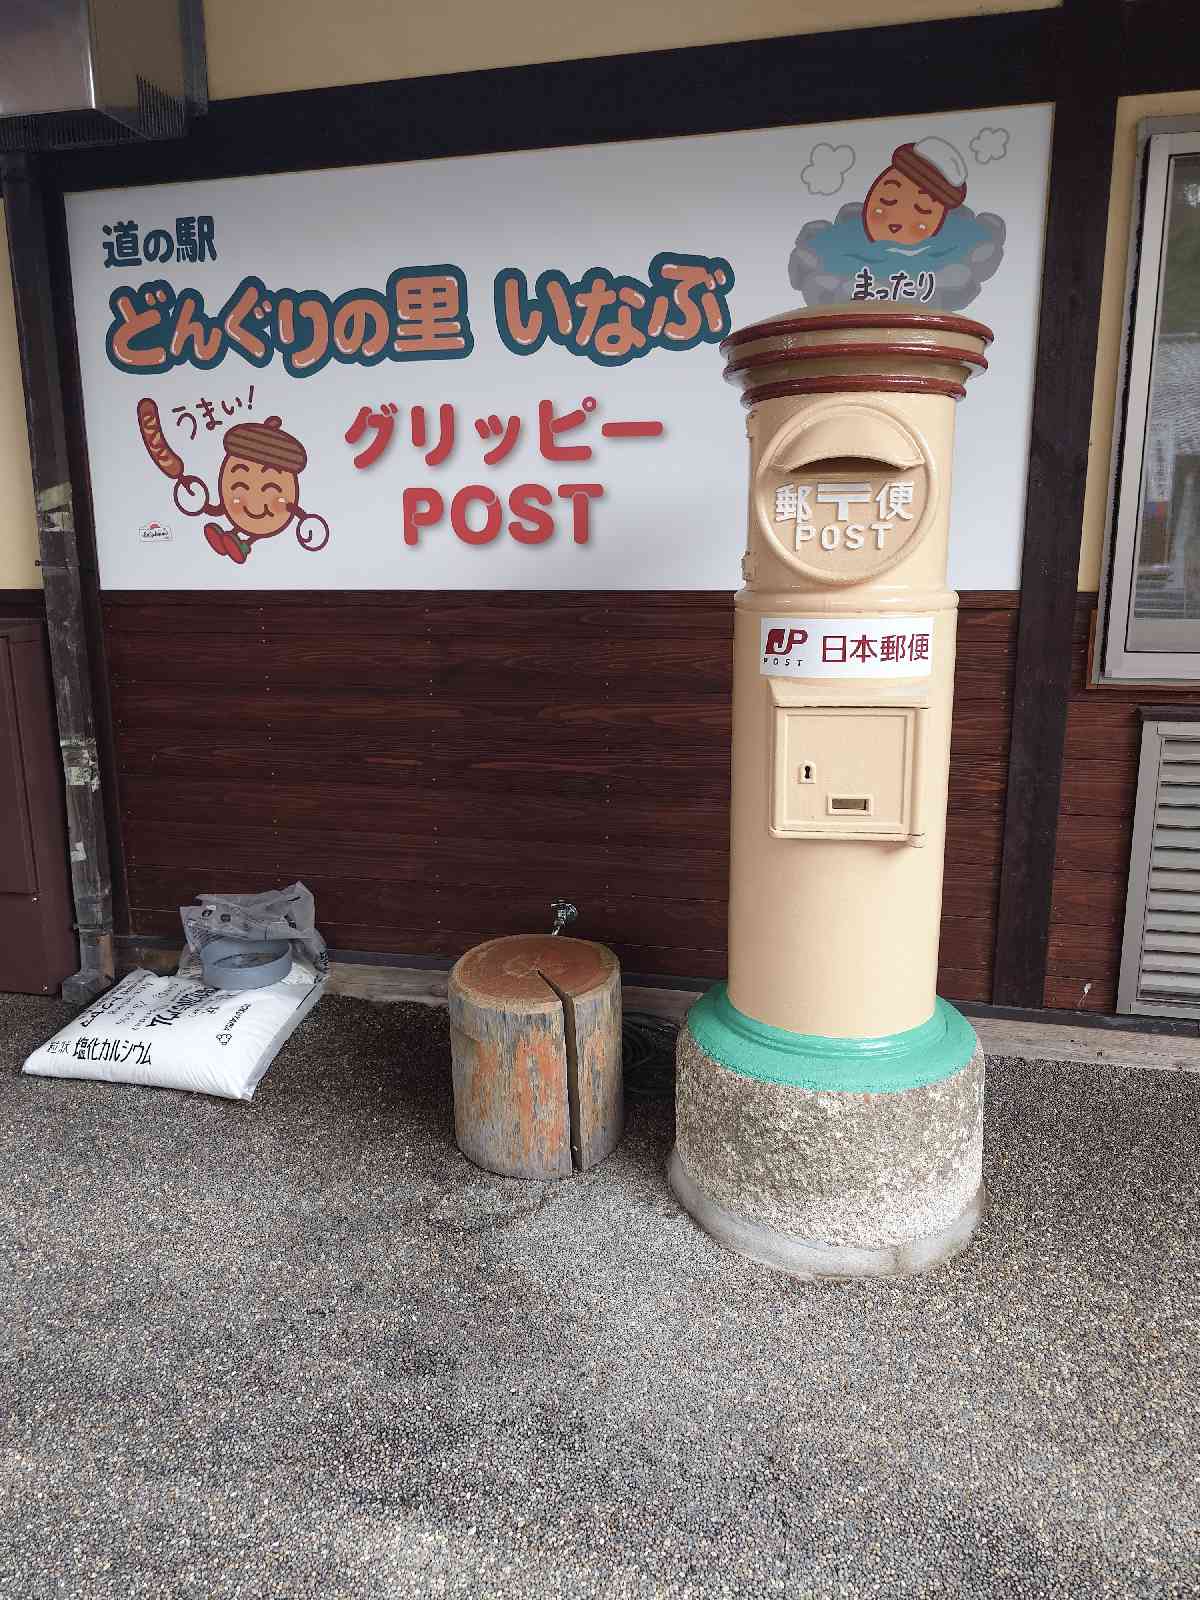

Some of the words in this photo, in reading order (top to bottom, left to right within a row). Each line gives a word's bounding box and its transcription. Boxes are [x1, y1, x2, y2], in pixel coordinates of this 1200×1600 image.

[102, 216, 218, 268] 道の駅
[850, 267, 935, 302] まったり
[106, 263, 474, 377] どんぐりの里
[494, 252, 735, 367] いなぶ
[345, 396, 663, 470] グリッピー
[402, 484, 604, 545] POST
[795, 522, 894, 551] POST
[762, 657, 804, 667] POST
[821, 633, 930, 663] 日本郵便
[72, 1036, 152, 1064] 塩化カルシウム
